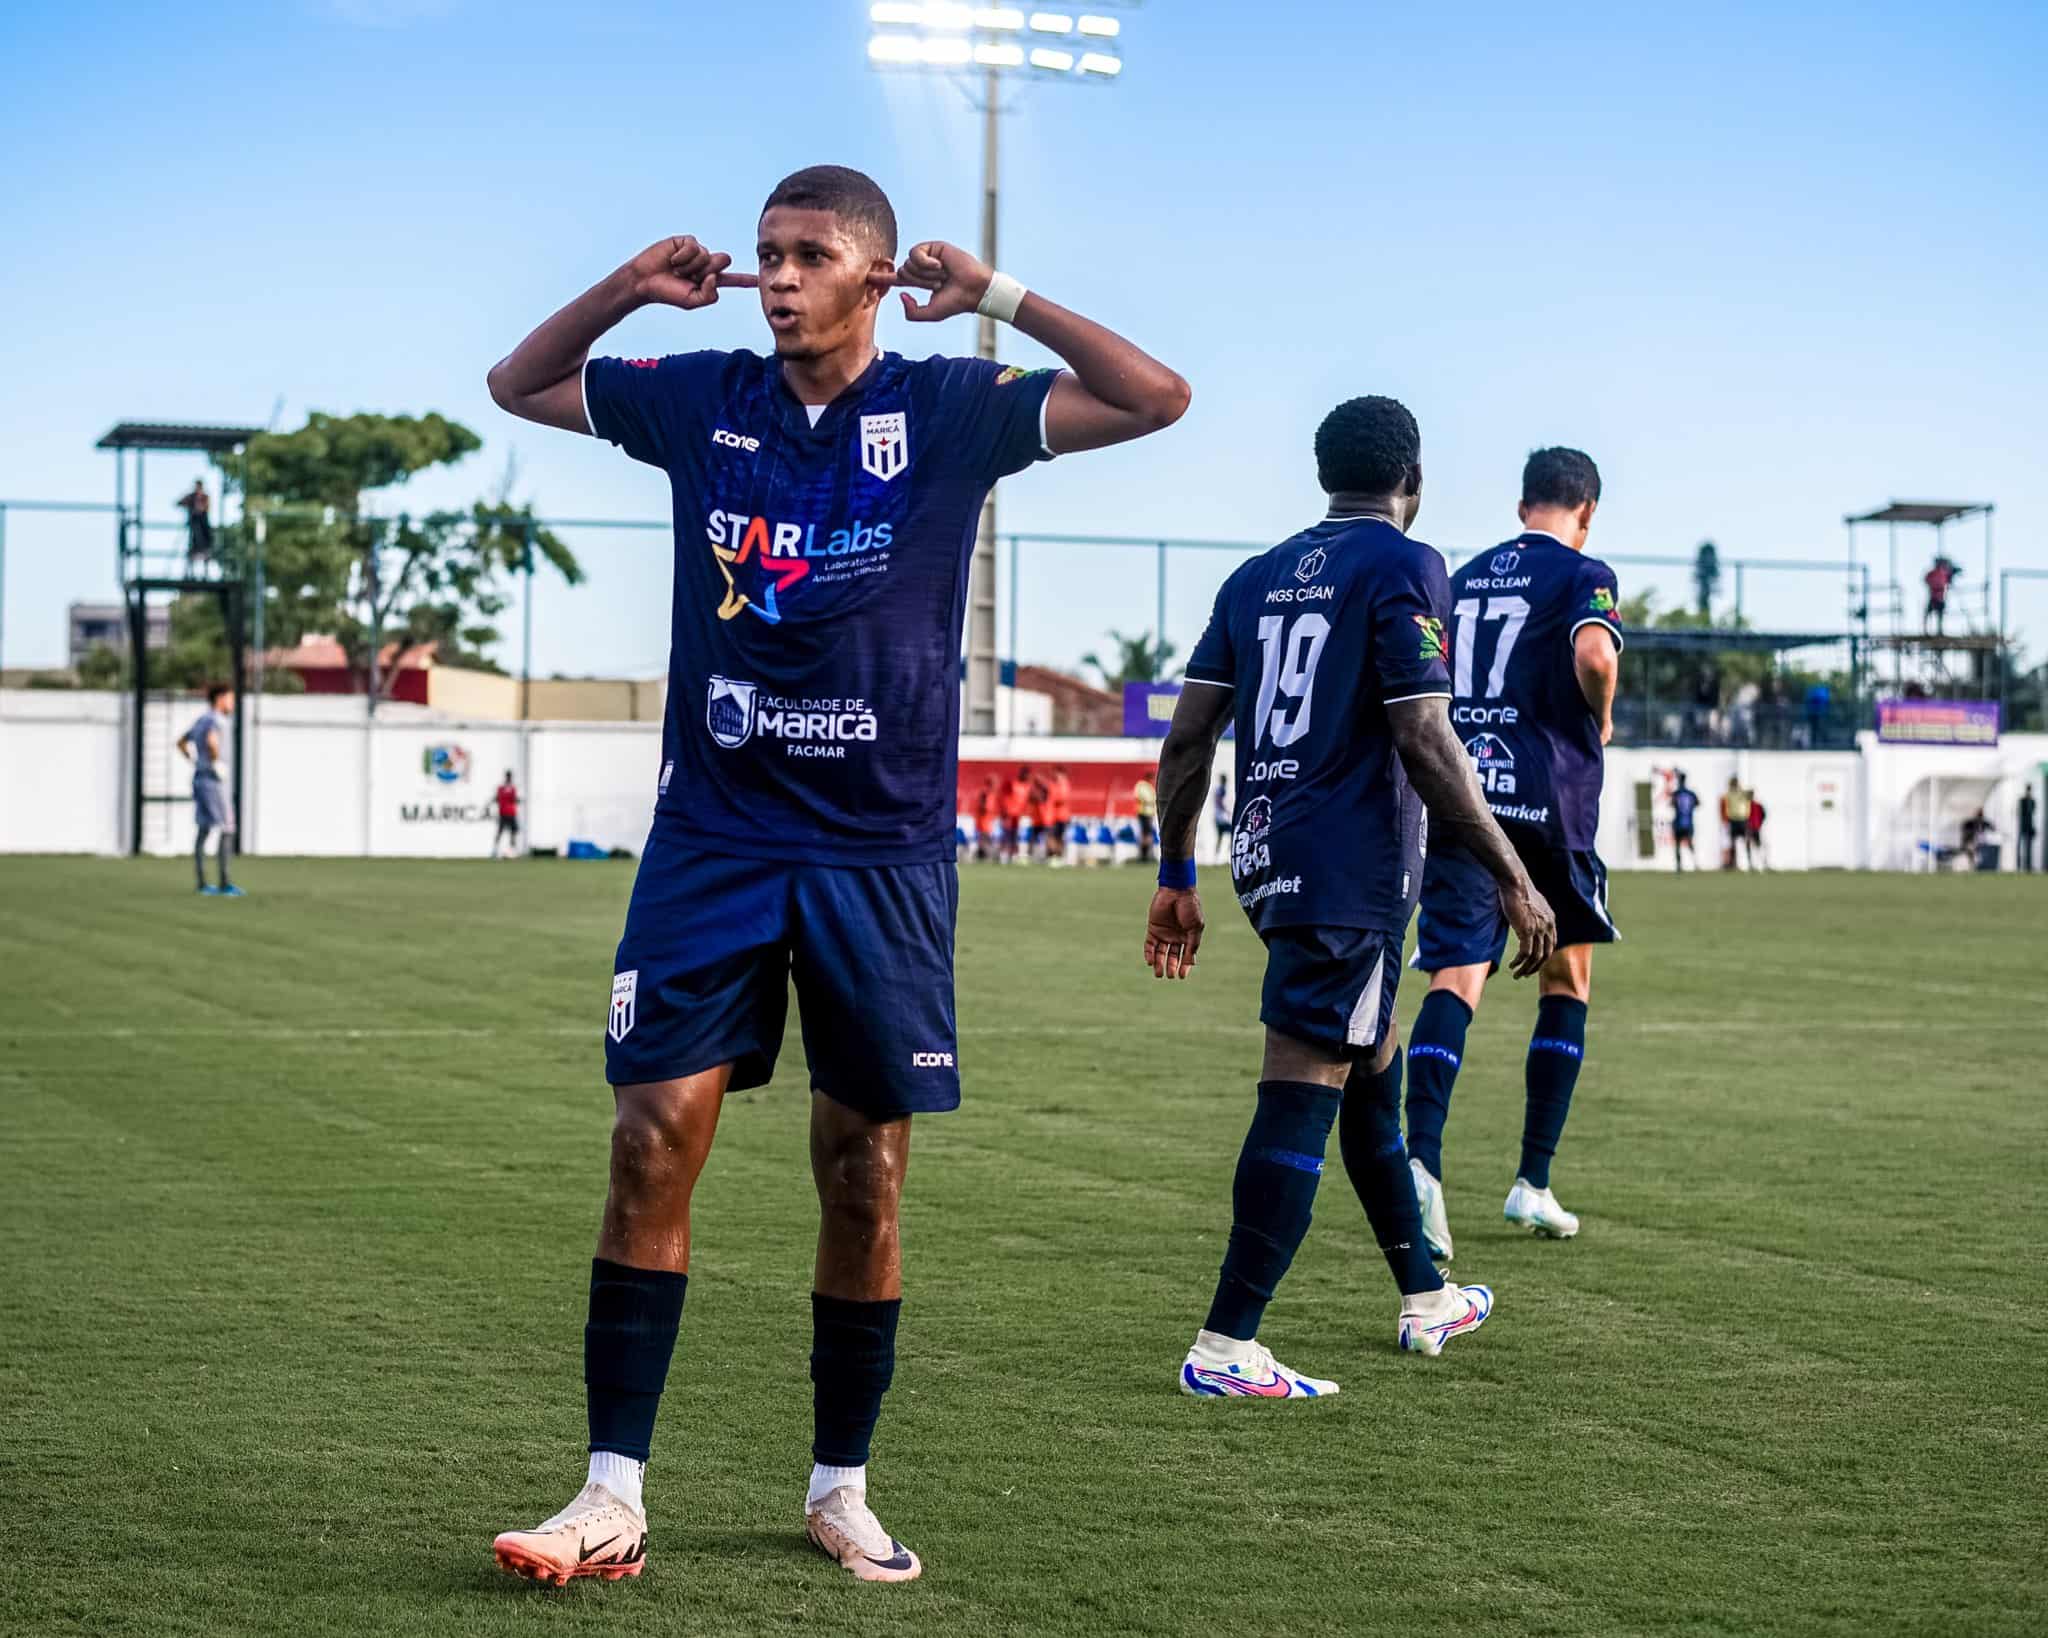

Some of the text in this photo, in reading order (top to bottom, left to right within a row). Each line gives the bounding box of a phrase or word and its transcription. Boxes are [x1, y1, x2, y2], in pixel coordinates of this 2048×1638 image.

[1491, 576, 1531, 589] CLEAN
[1296, 585, 1335, 602] CLEAN
[1454, 596, 1531, 698] 17
[1255, 613, 1331, 750] 19
[758, 696, 865, 711] FACULDADE DE
[787, 745, 845, 758] FACMAR
